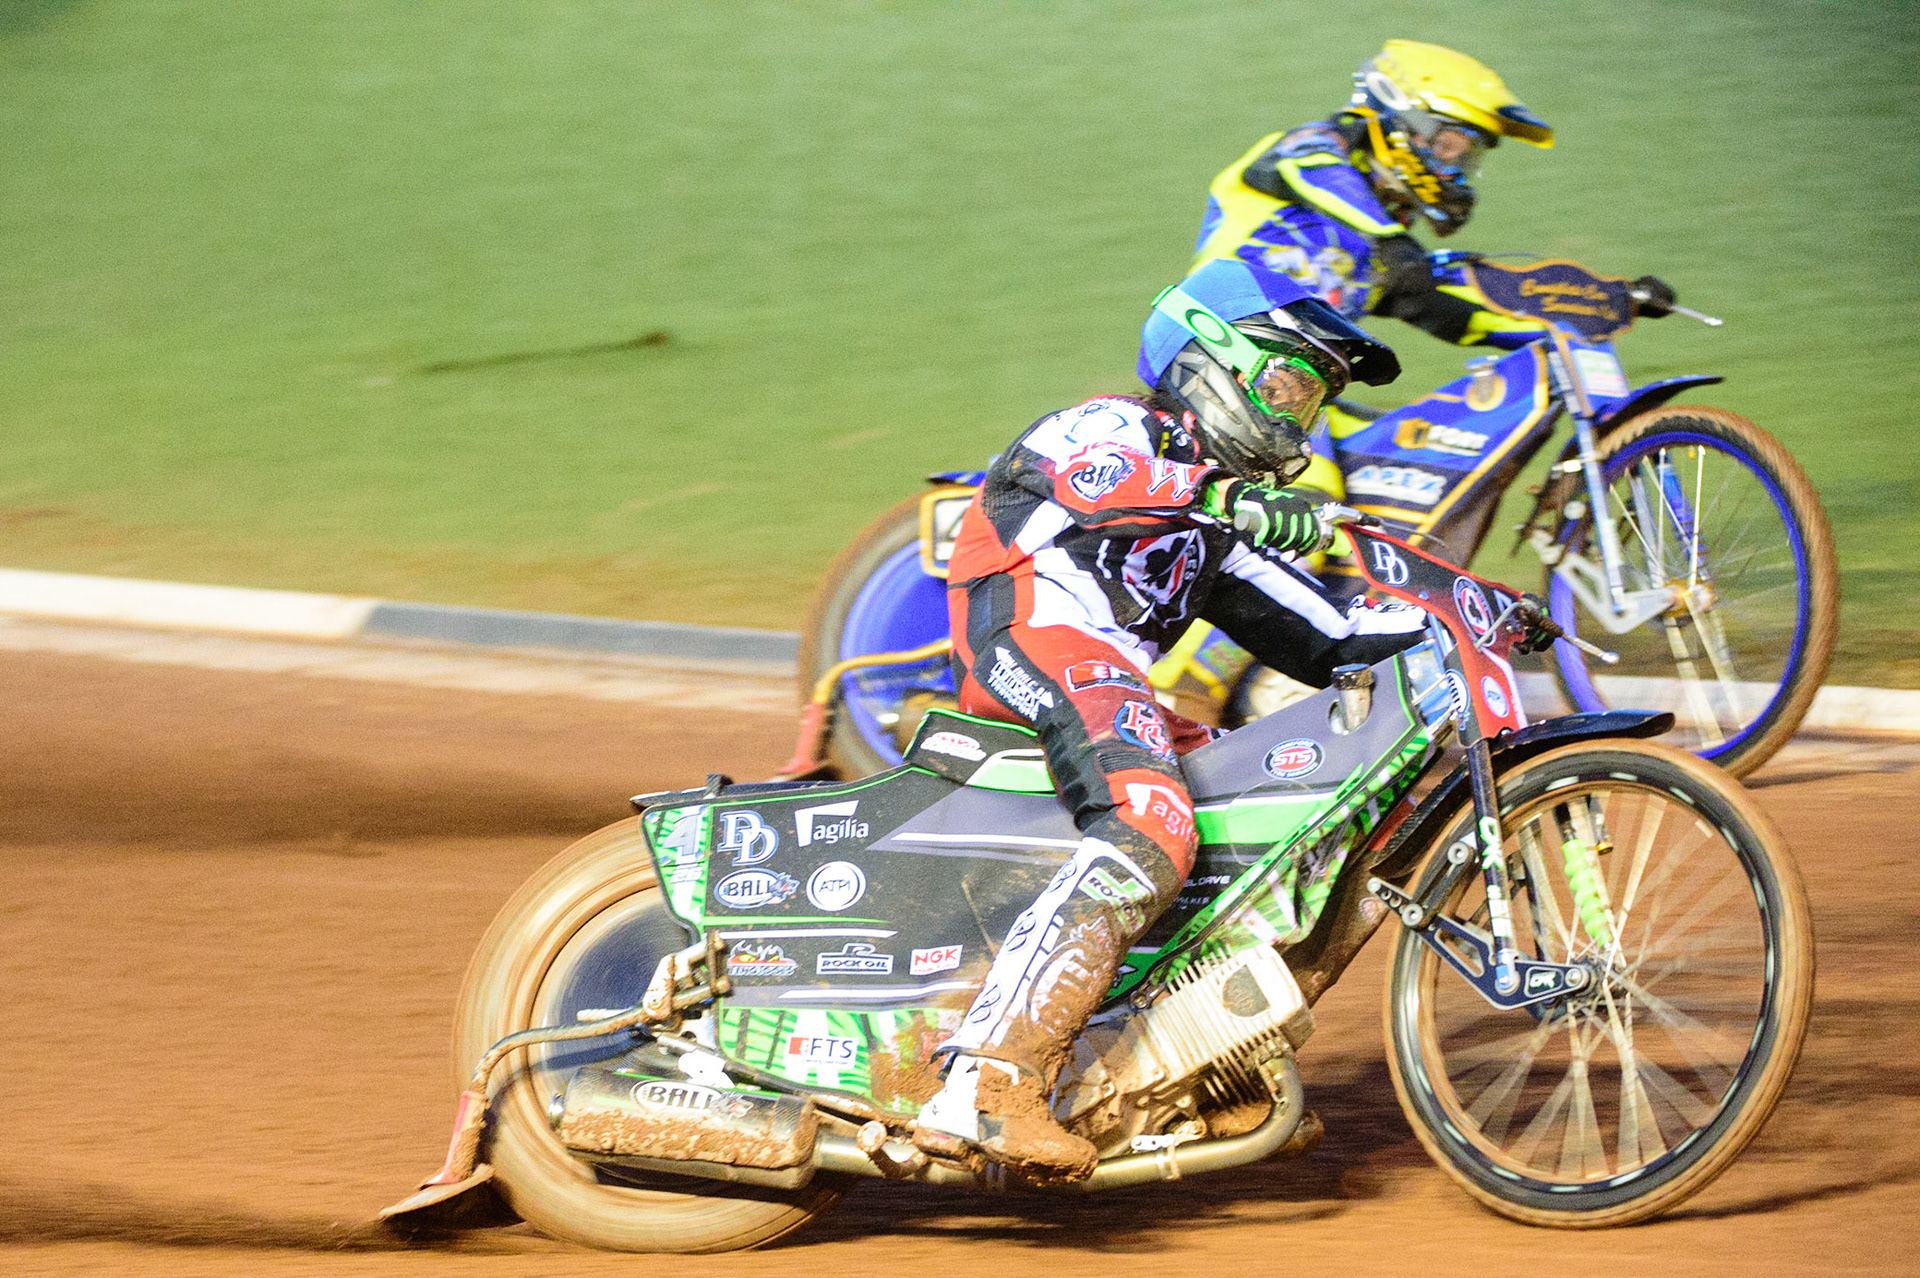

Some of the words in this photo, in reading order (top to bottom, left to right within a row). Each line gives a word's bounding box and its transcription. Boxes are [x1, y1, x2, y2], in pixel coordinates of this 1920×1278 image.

[1273, 750, 1313, 767] STS
[813, 819, 870, 844] agilia
[819, 879, 850, 893] ATPI
[822, 959, 862, 969] ROCK
[864, 958, 888, 969] OIL
[914, 947, 958, 966] NGK
[810, 1037, 854, 1059] FTS
